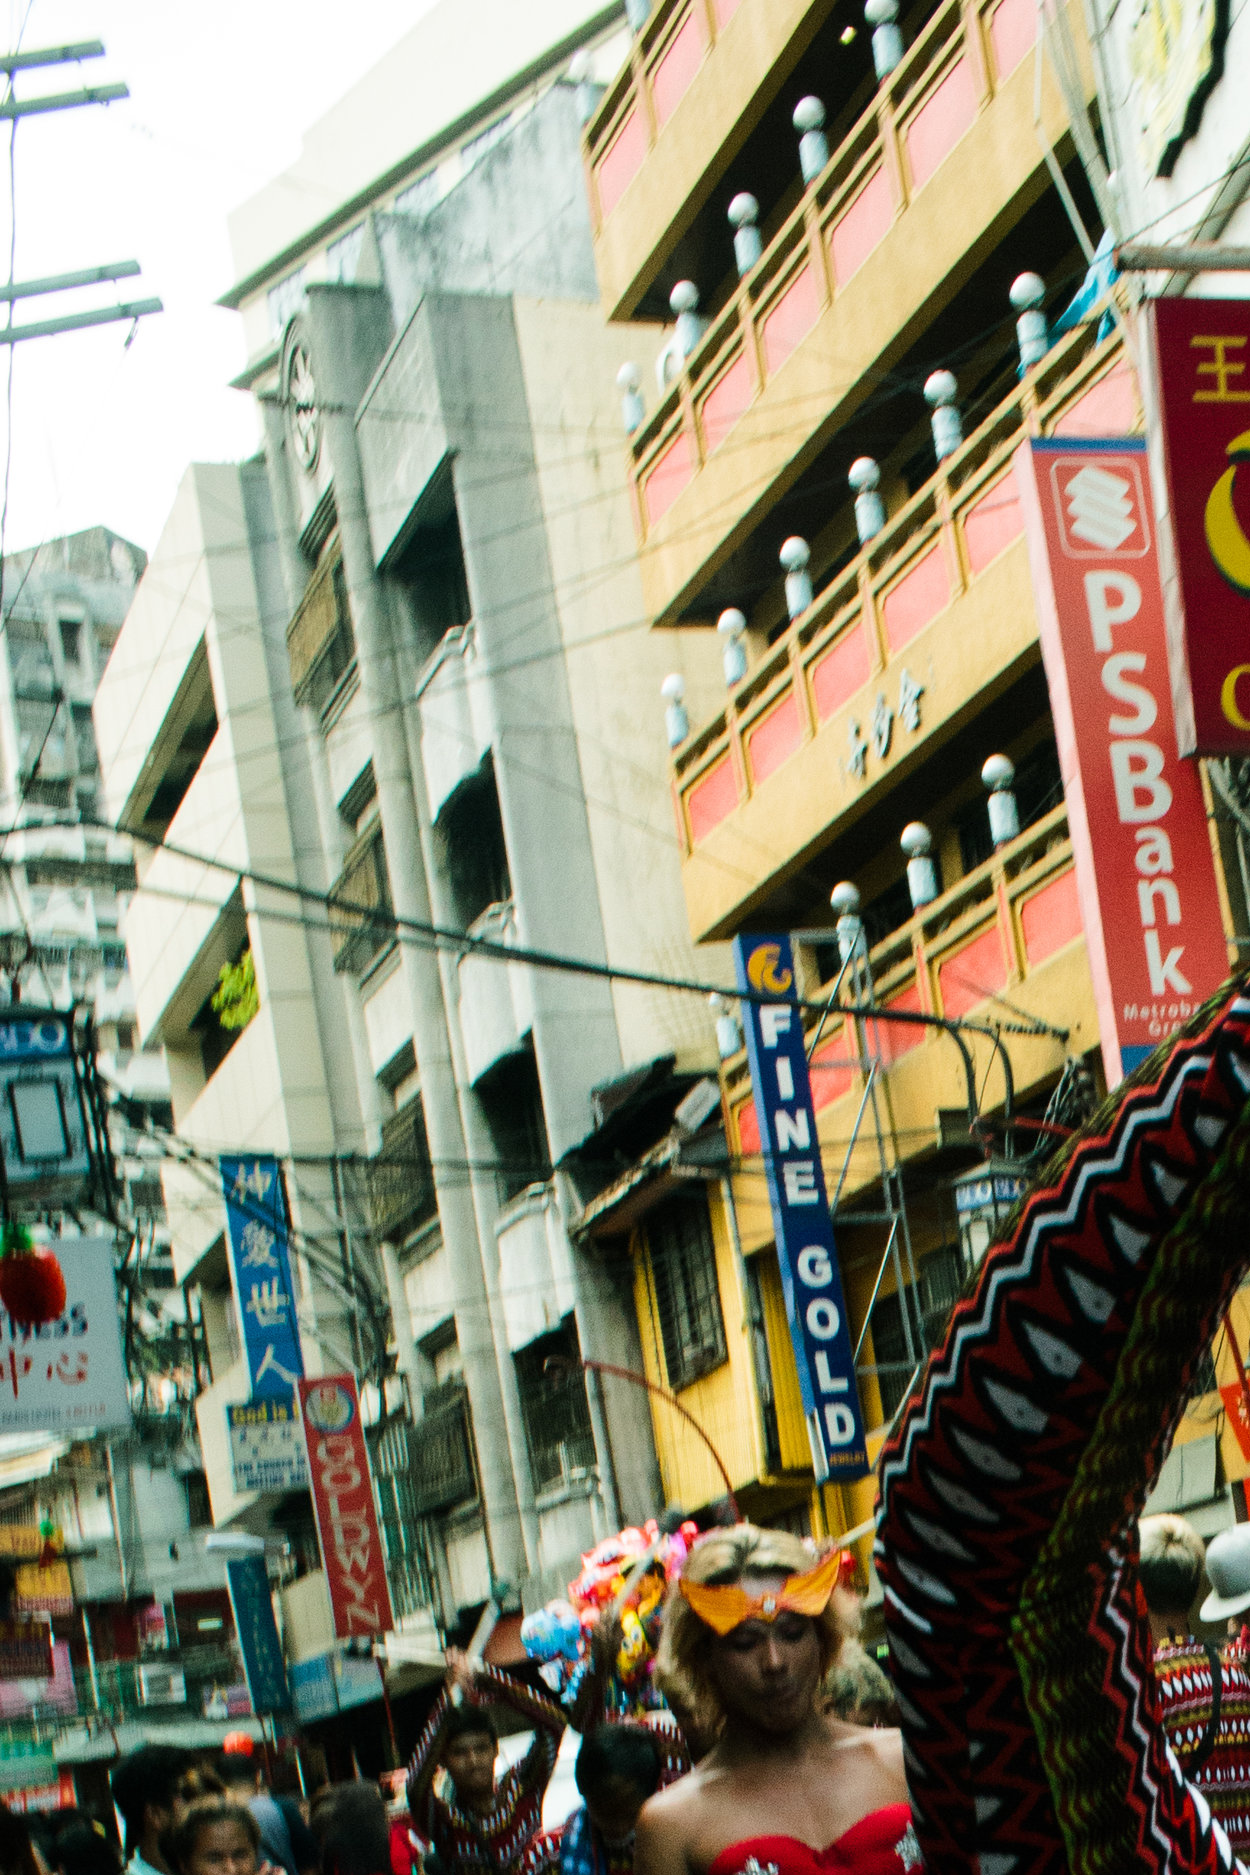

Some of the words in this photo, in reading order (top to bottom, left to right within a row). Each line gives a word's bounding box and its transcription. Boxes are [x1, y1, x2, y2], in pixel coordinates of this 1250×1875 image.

[1083, 569, 1192, 996] PSBank
[758, 1003, 820, 1207] FINE
[797, 1244, 857, 1447] GOLD
